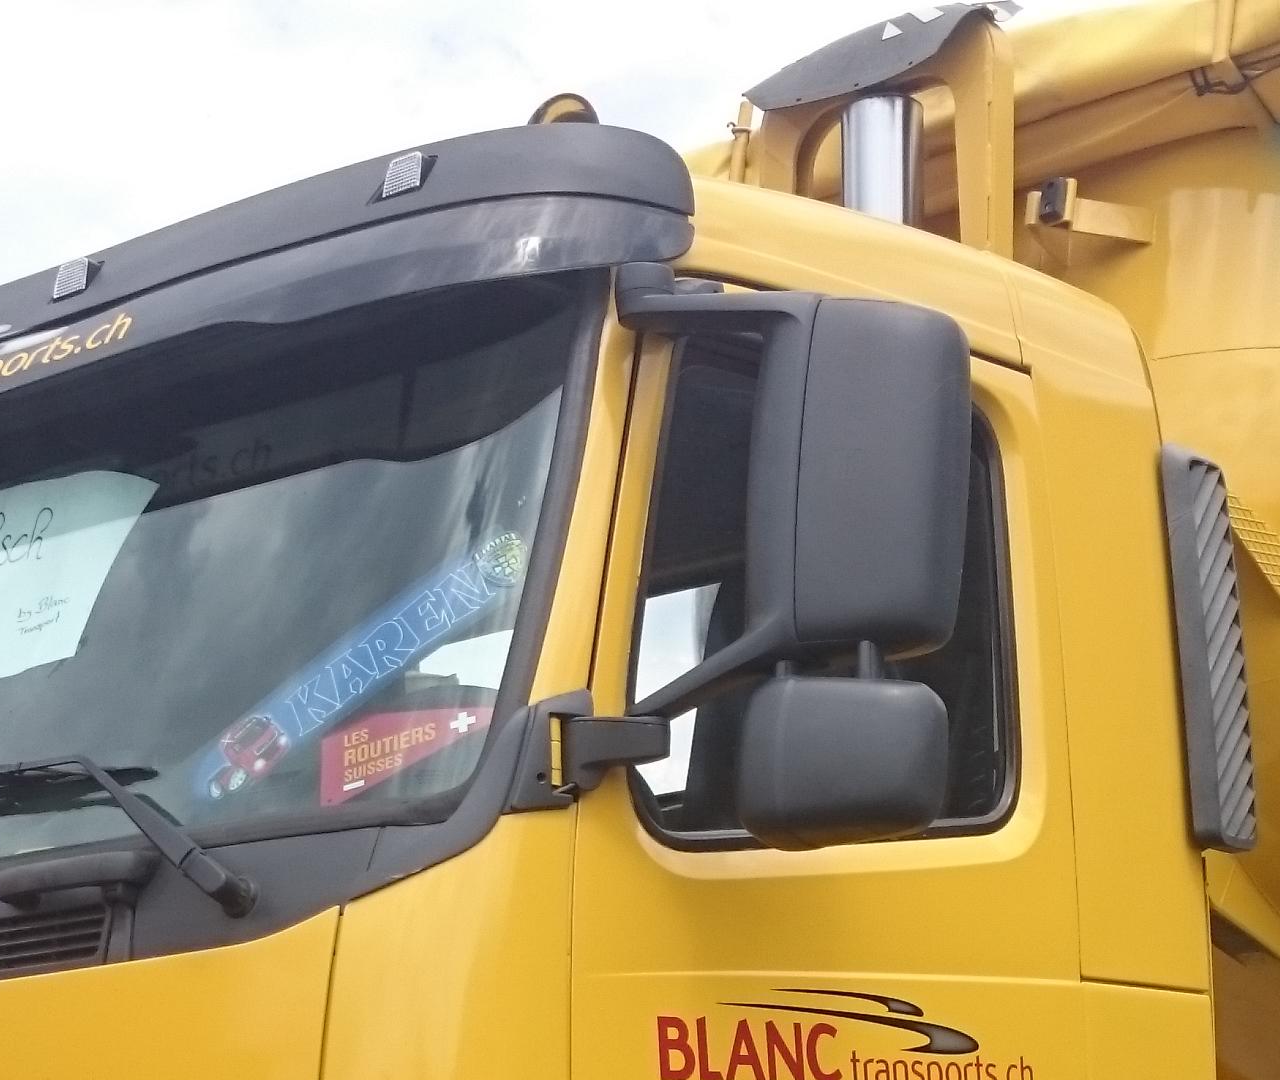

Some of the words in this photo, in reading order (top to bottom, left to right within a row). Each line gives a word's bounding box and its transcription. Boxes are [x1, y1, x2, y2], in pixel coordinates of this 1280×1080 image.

[284, 561, 497, 737] KAREN
[343, 723, 437, 767] ROUTIERS
[344, 729, 369, 747] LES
[344, 753, 403, 782] SUISSES
